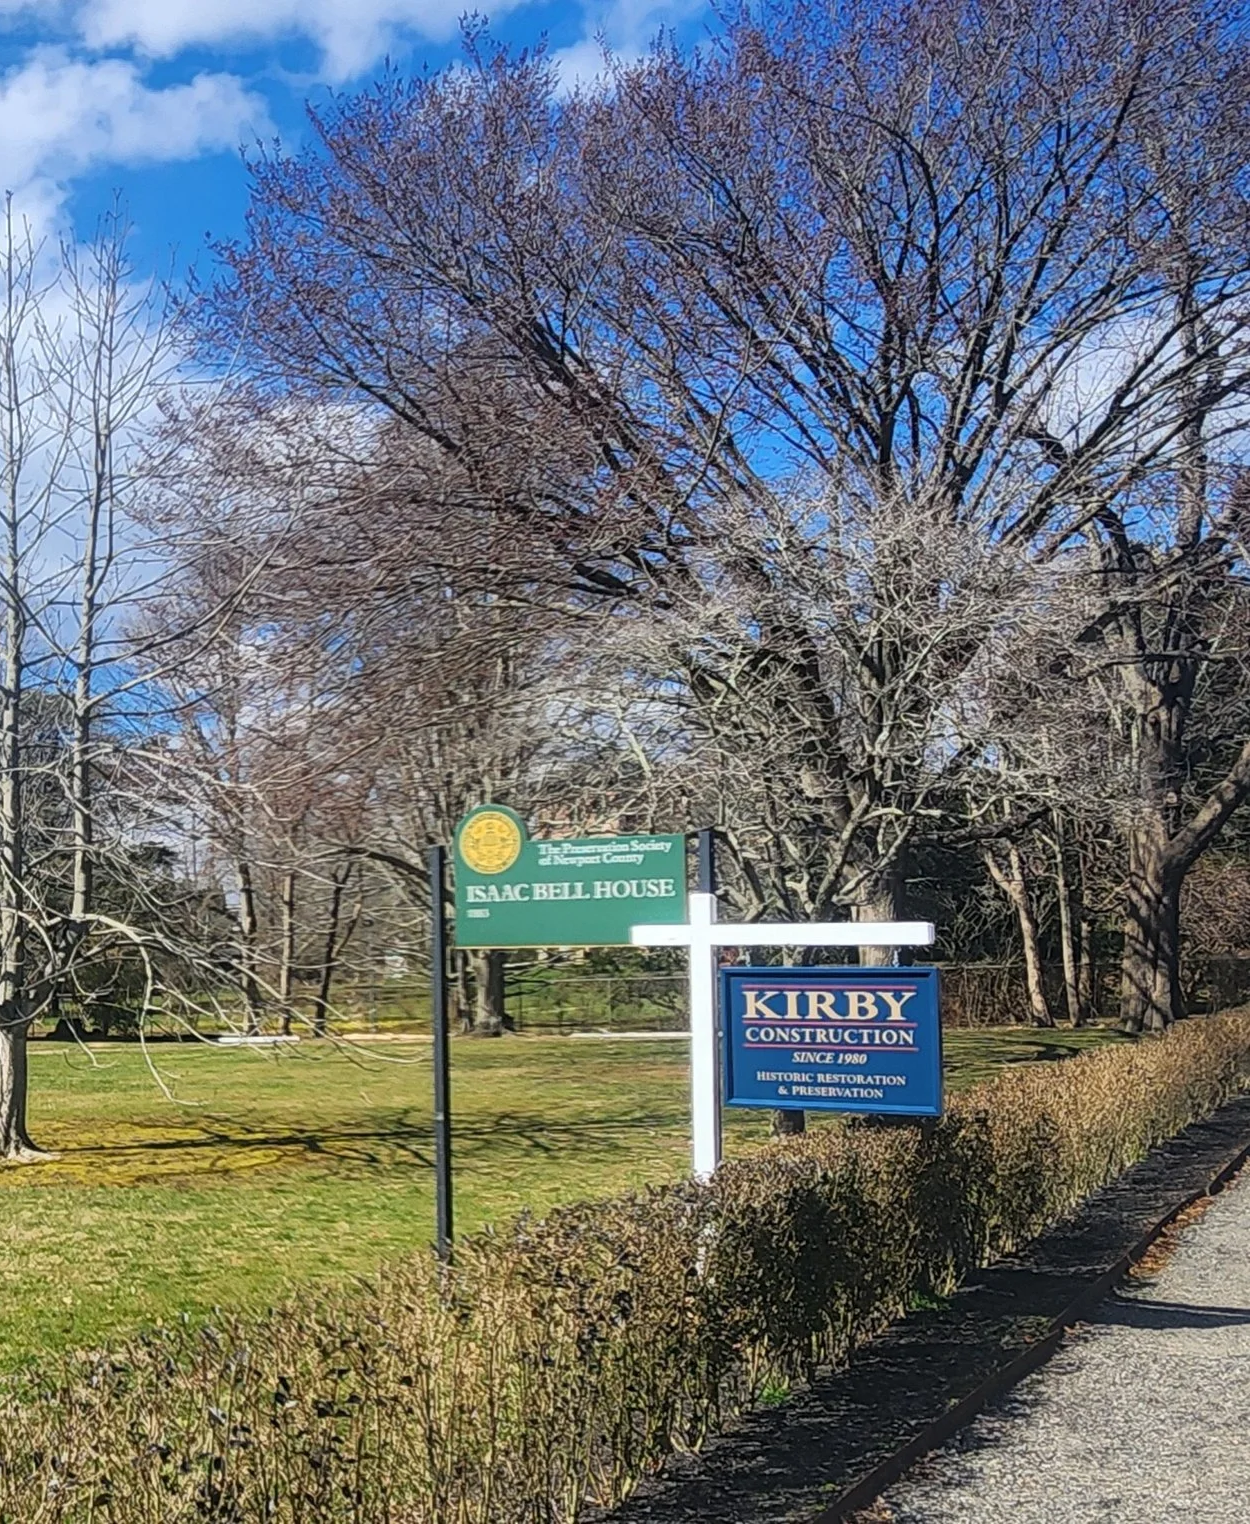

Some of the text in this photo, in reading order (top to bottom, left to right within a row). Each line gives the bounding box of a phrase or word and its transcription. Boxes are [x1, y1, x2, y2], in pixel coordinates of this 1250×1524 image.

[629, 840, 672, 852] Society
[466, 879, 676, 903] ISAAC BELL HOUSE
[742, 990, 917, 1021] KIRBY
[745, 1027, 914, 1045] CONSTRUCTION
[792, 1052, 868, 1065] SINCE 1980
[756, 1071, 906, 1086] HISTORIC RESTORATION
[778, 1085, 883, 1099] & PRESERVATION
